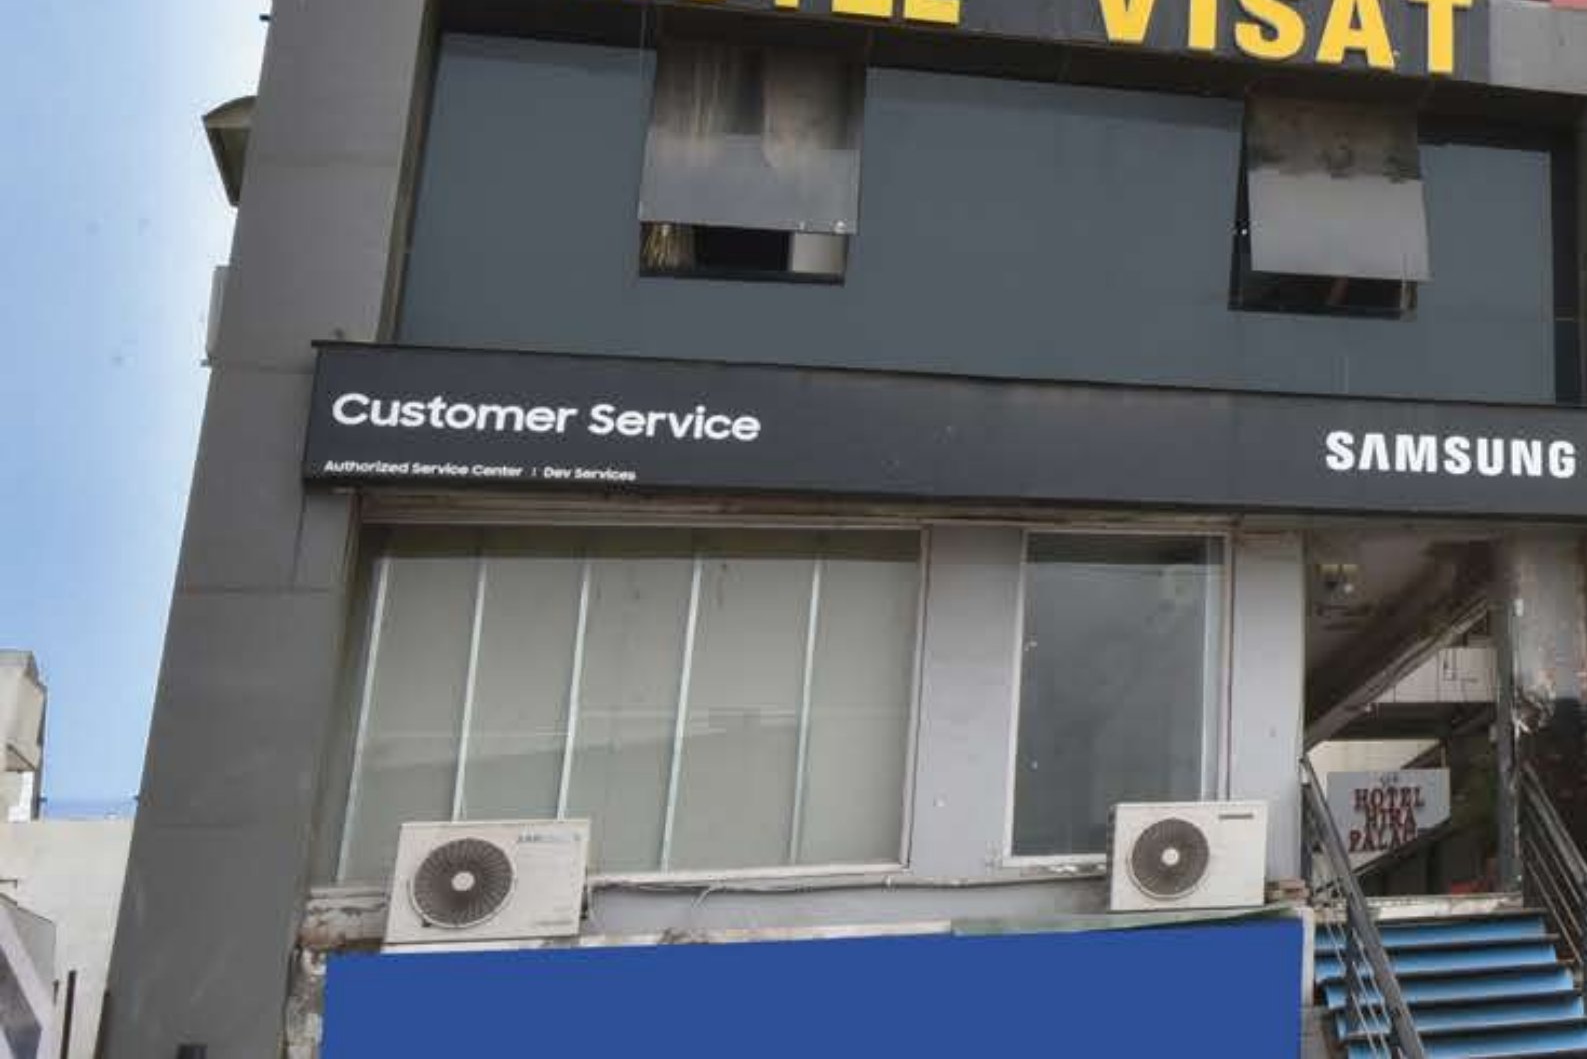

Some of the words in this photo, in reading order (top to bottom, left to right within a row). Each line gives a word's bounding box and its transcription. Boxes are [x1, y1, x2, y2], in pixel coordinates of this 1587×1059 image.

[332, 392, 577, 434] Customer
[588, 403, 761, 442] Service
[324, 460, 409, 475] Authorized
[412, 462, 468, 476] Service
[472, 464, 523, 477] Center
[543, 466, 571, 479] Dev
[574, 467, 636, 481] Services
[1325, 430, 1577, 479] SAMSUNG
[1354, 787, 1425, 810] HOTEL
